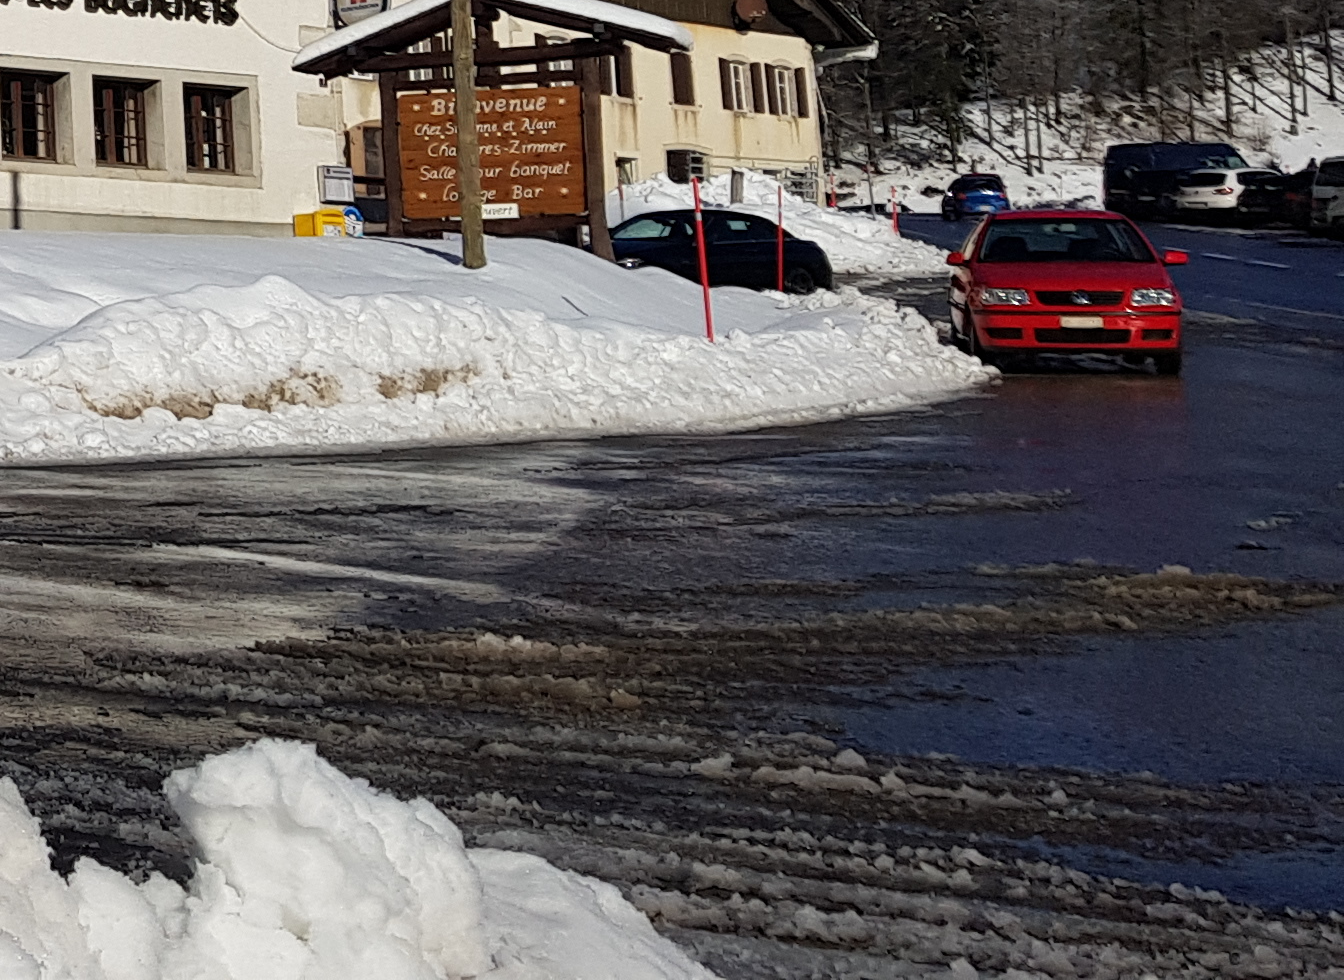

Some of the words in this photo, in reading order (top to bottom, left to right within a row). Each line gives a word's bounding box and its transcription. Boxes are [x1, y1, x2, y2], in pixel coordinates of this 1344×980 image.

[430, 96, 547, 116] Bivenue
[414, 123, 441, 136] Chez
[503, 120, 514, 132] et
[520, 118, 556, 132] Alain
[427, 140, 567, 157] Chares-Zimmer
[419, 165, 456, 181] Salle
[479, 166, 503, 177] our
[509, 161, 571, 180] banquet
[512, 185, 544, 200] Bar
[483, 206, 513, 216] uvert
